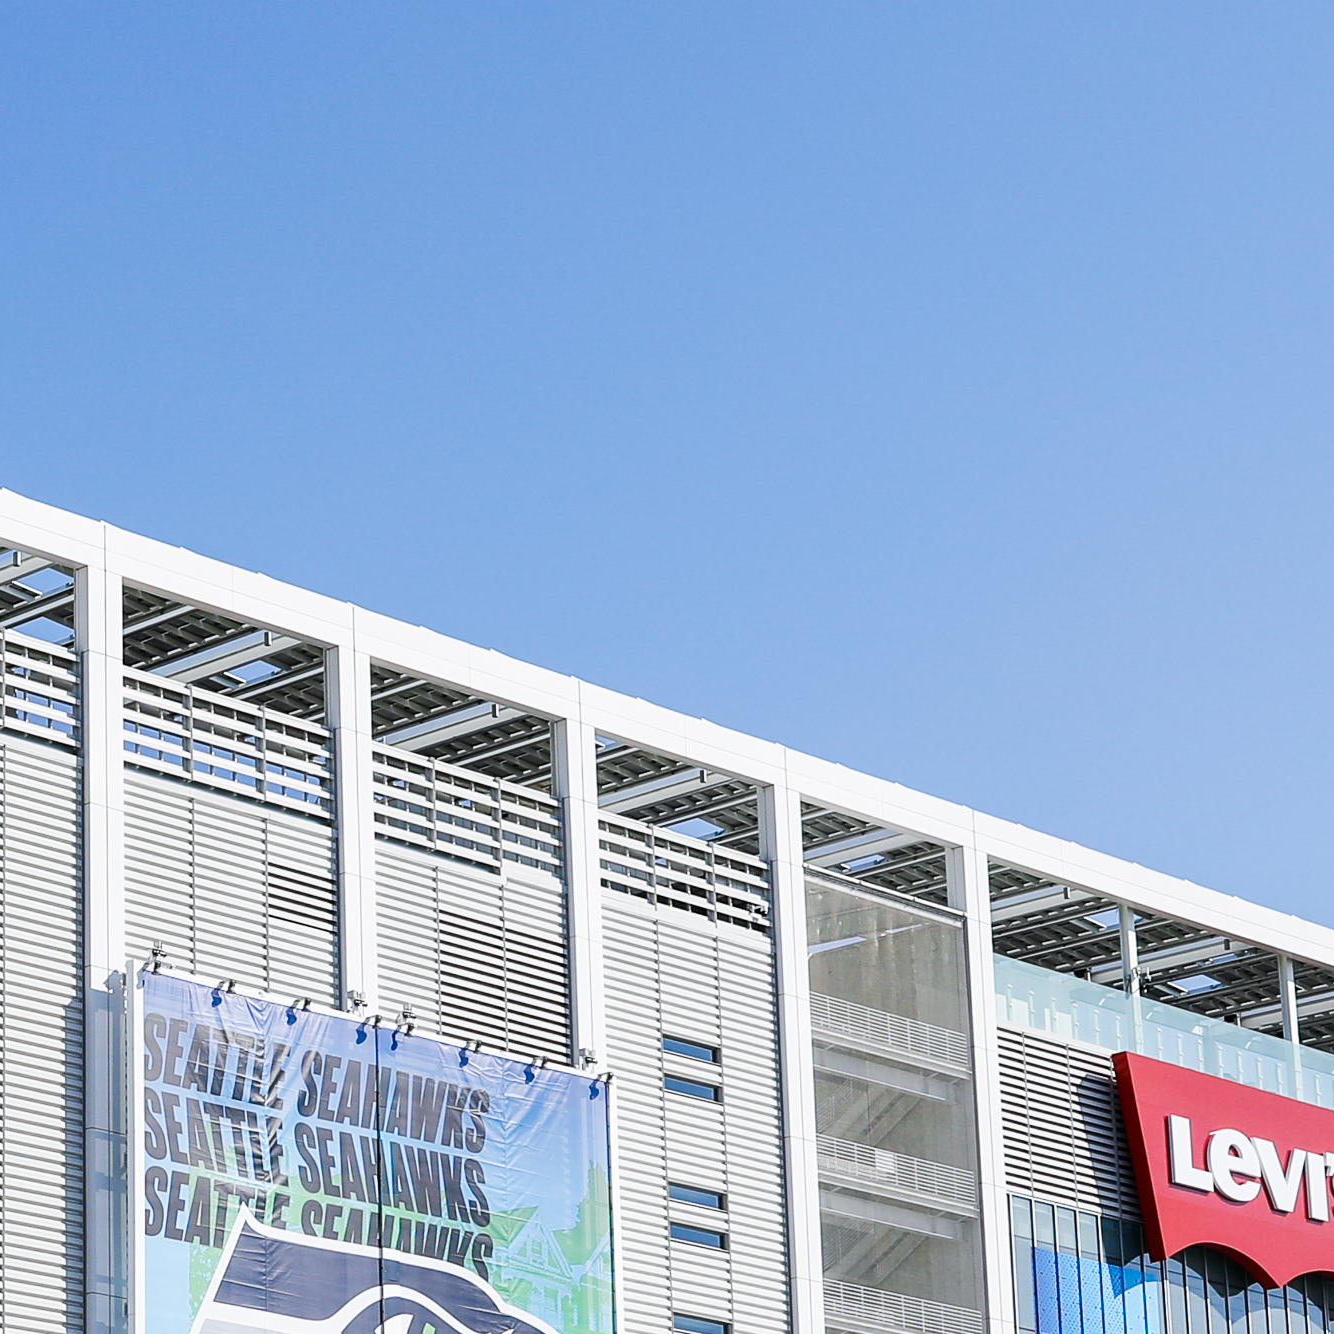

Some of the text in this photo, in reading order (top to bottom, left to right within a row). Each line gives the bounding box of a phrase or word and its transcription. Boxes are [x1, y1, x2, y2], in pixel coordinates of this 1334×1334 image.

[143, 1012, 491, 1154] SEATTLE SEAHAWKS
[143, 1086, 491, 1228] SEATTLE SEAHAWKS
